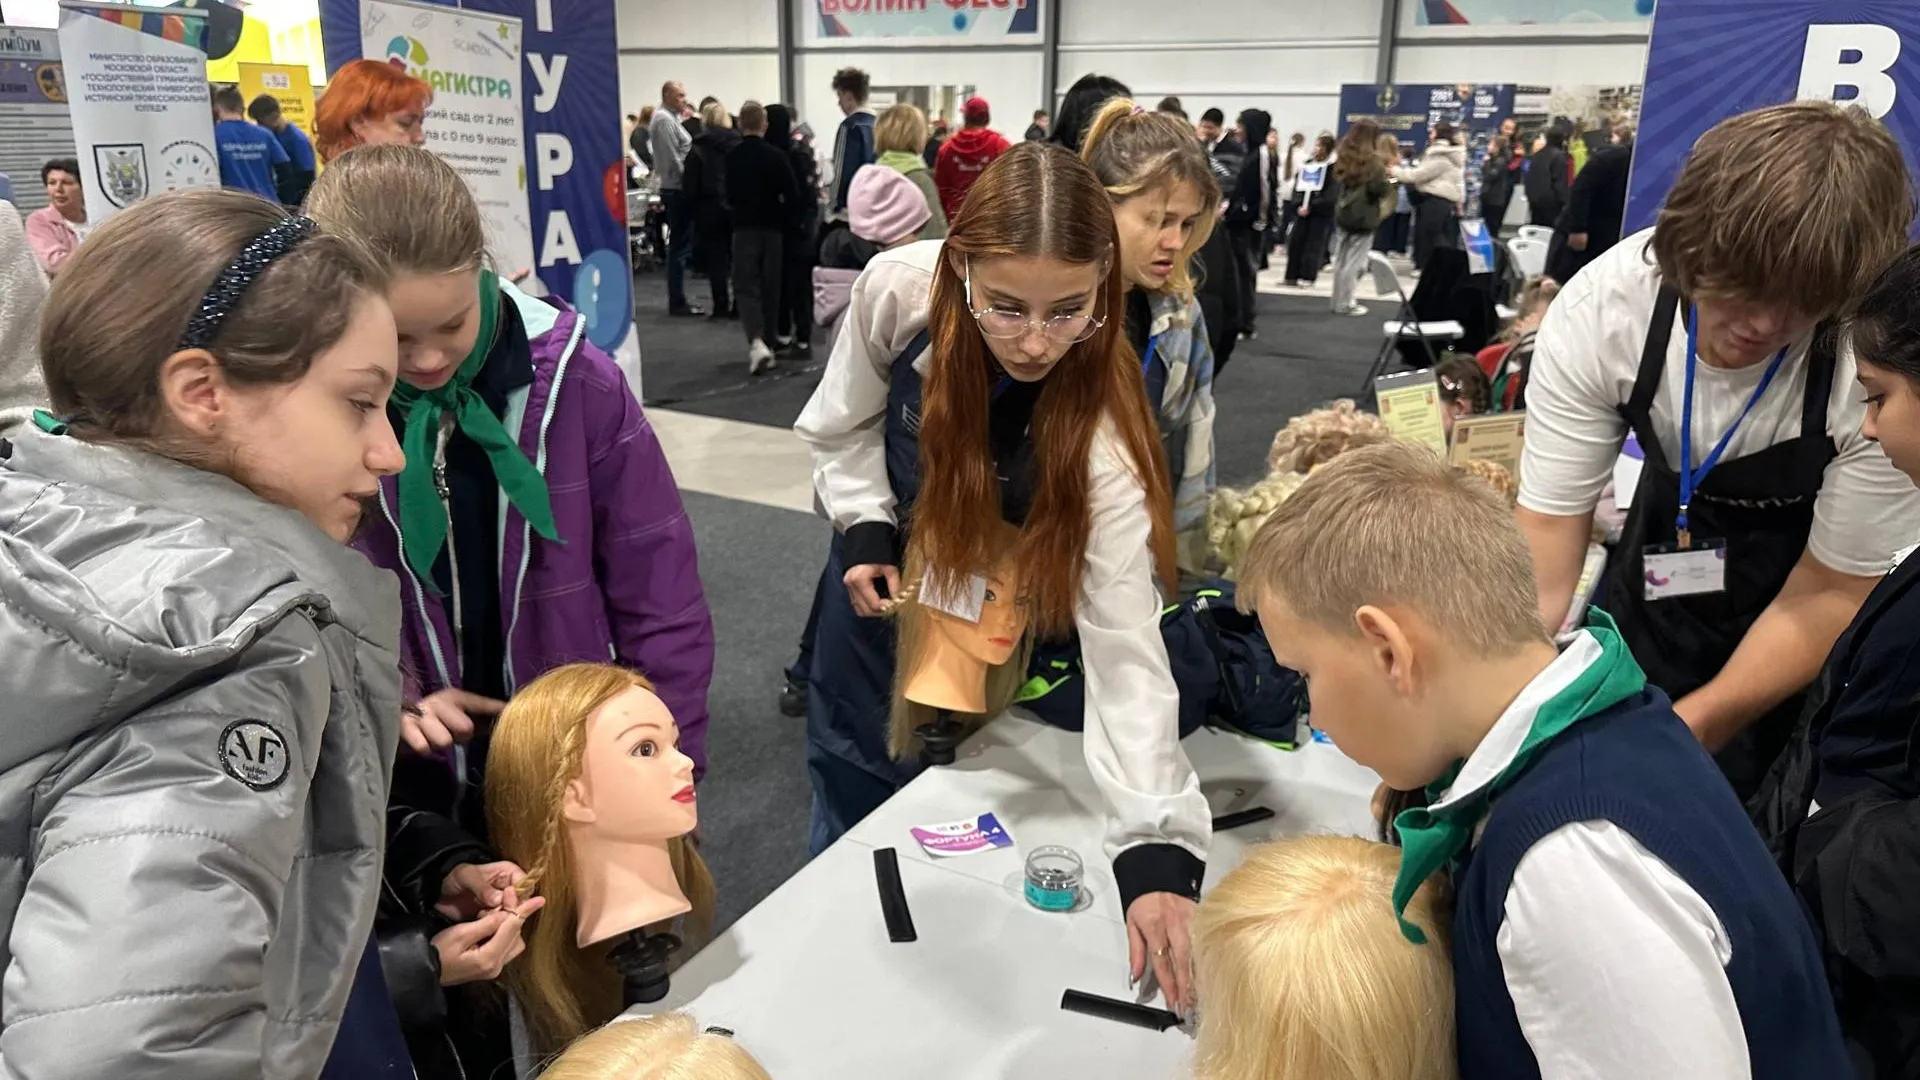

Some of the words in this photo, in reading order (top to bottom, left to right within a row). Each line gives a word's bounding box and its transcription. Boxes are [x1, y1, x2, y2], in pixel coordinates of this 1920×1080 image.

[1795, 24, 1901, 120] В
[450, 110, 471, 123] сад
[473, 114, 485, 124] от
[487, 114, 494, 125] 2
[496, 116, 514, 127] лет
[441, 132, 448, 141] с
[460, 133, 475, 144] по
[476, 132, 484, 144] 9
[486, 136, 518, 148] класс
